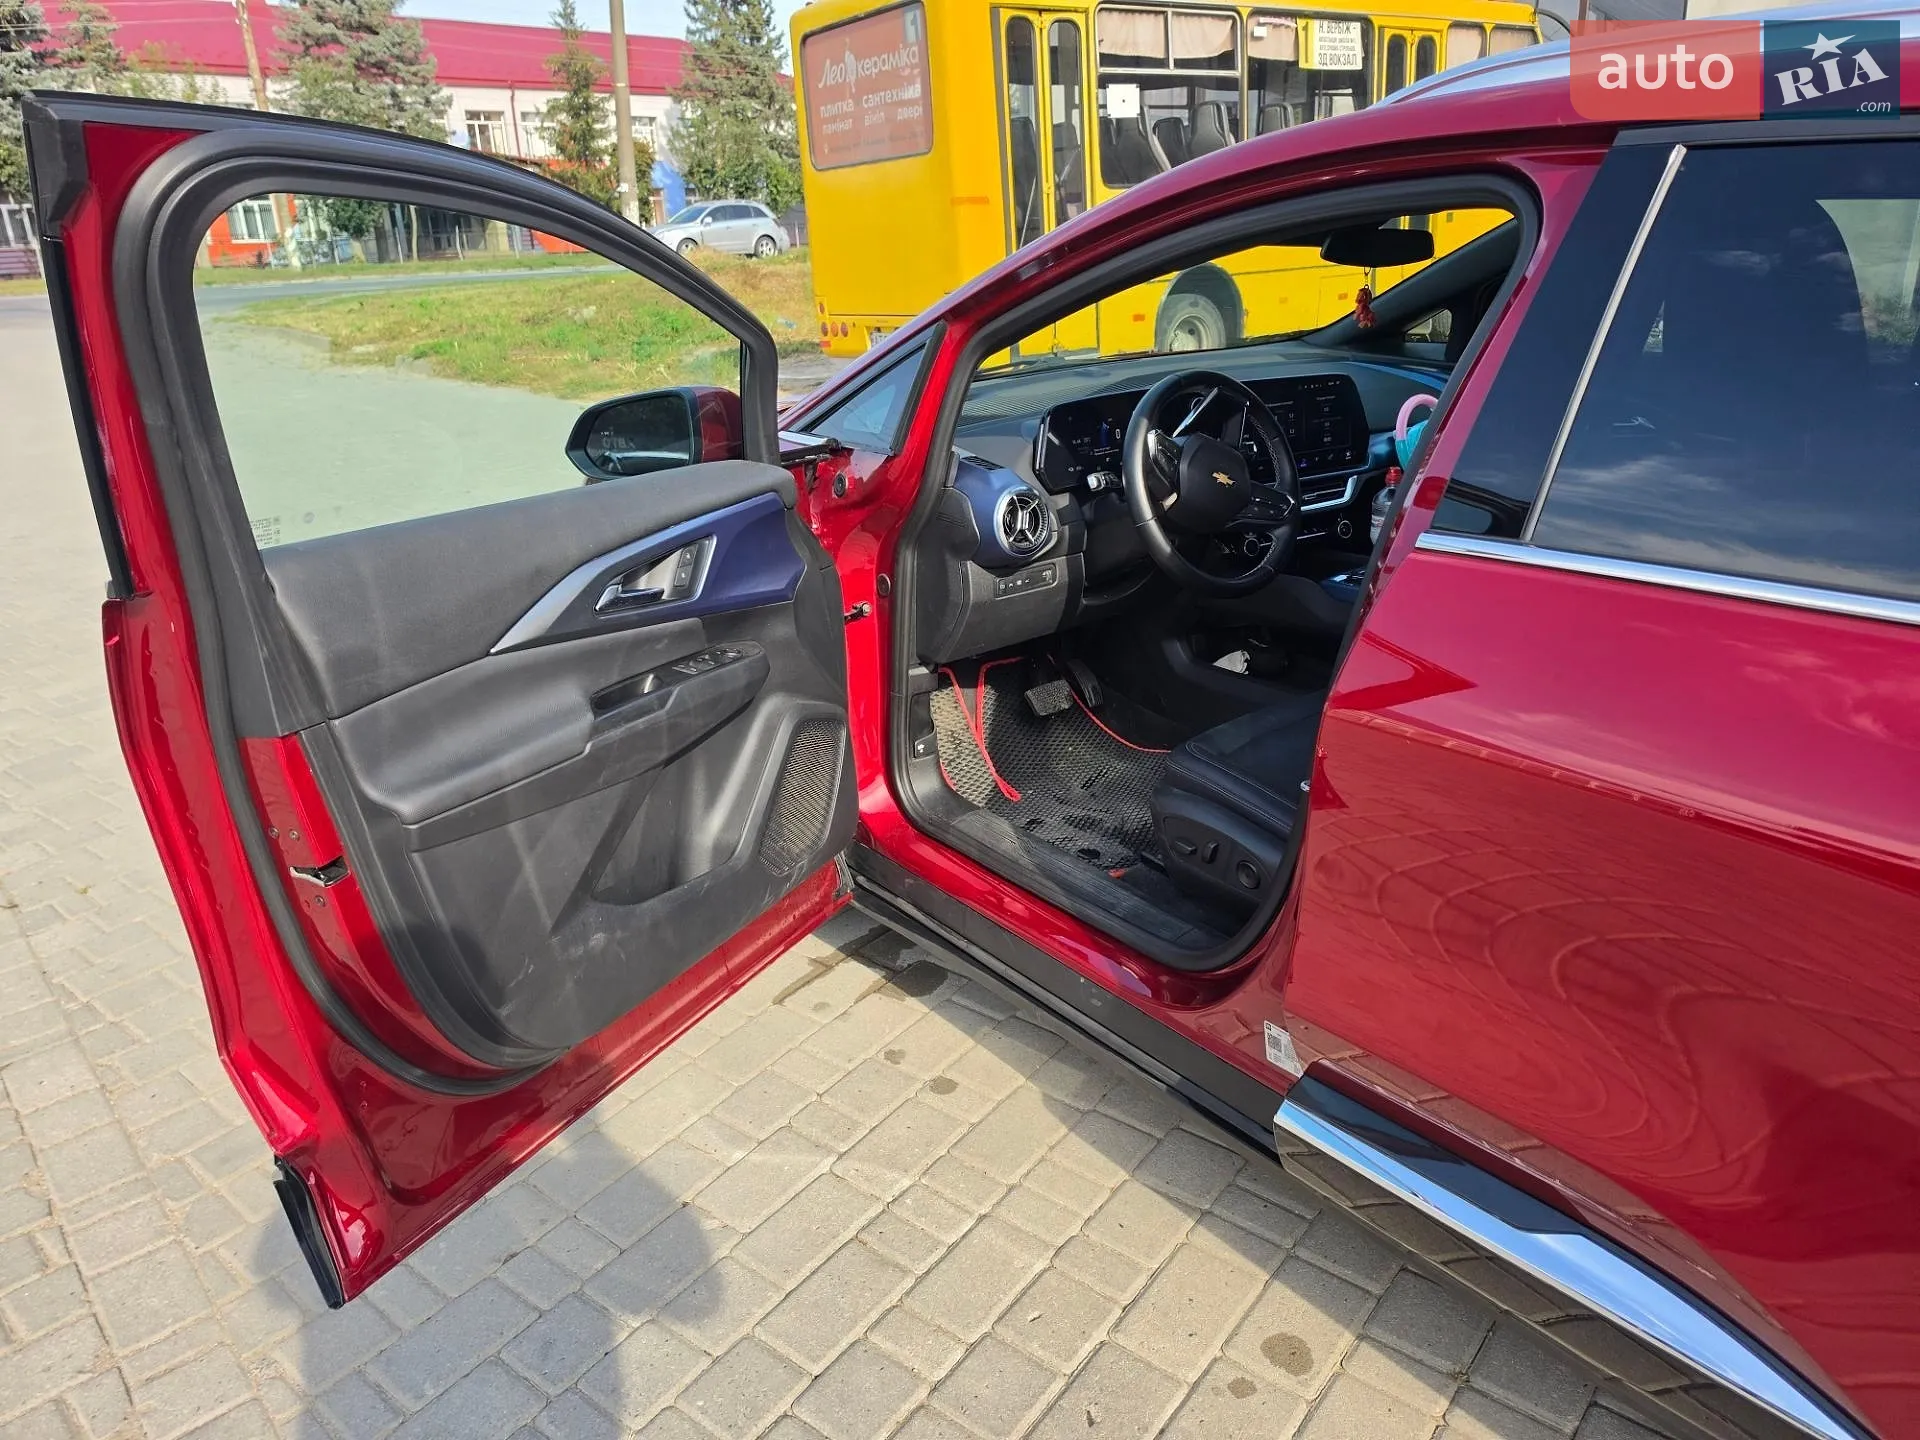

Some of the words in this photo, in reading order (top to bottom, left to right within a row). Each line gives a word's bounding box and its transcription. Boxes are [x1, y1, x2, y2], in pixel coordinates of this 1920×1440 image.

[1302, 21, 1309, 64] 1
[1329, 54, 1358, 66] ВОКЗАЛ
[818, 58, 845, 89] Лео
[857, 44, 920, 78] кераміка
[820, 99, 855, 118] плитка
[862, 80, 922, 108] сантехніка
[897, 105, 923, 122] двері
